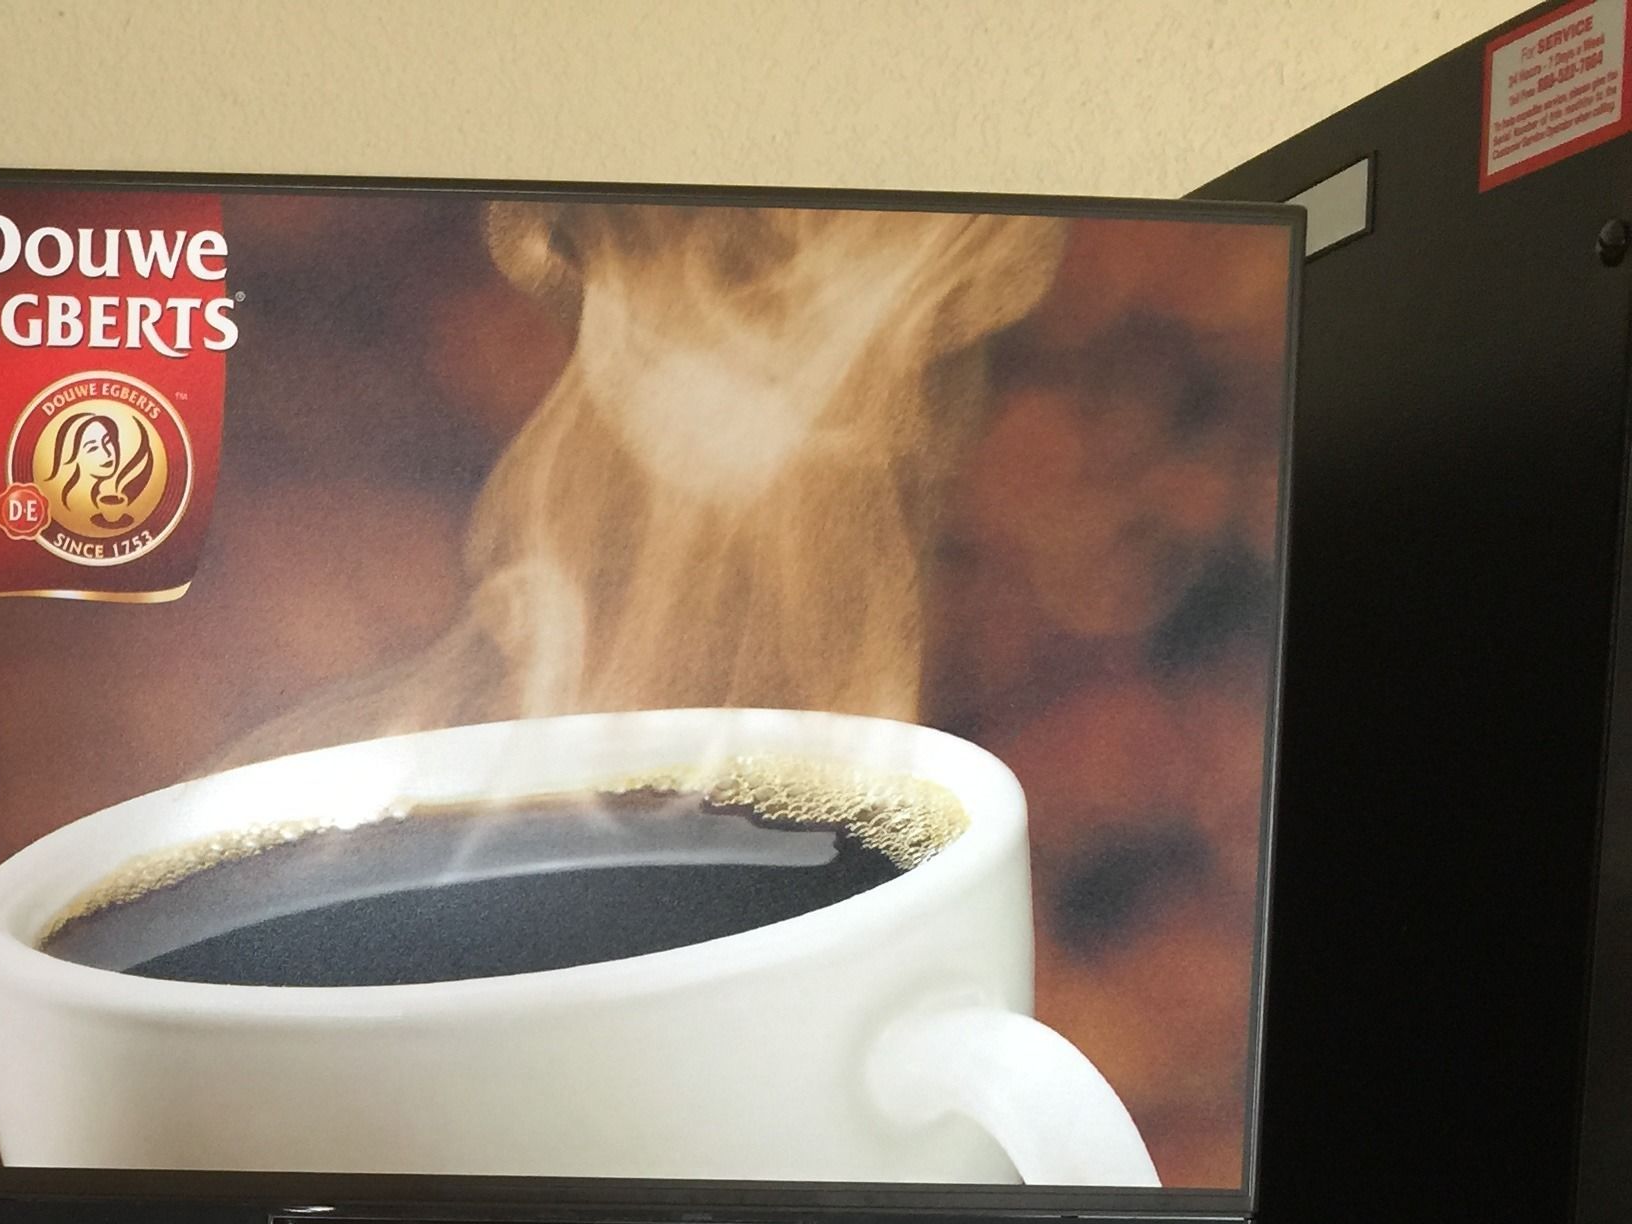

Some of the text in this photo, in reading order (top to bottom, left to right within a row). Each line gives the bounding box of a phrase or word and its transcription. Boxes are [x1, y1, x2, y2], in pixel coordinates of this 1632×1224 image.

[1537, 16, 1593, 54] SERVICE
[42, 383, 161, 420] DOUWE EGBERTS
[53, 529, 154, 559] SINCE 1753
